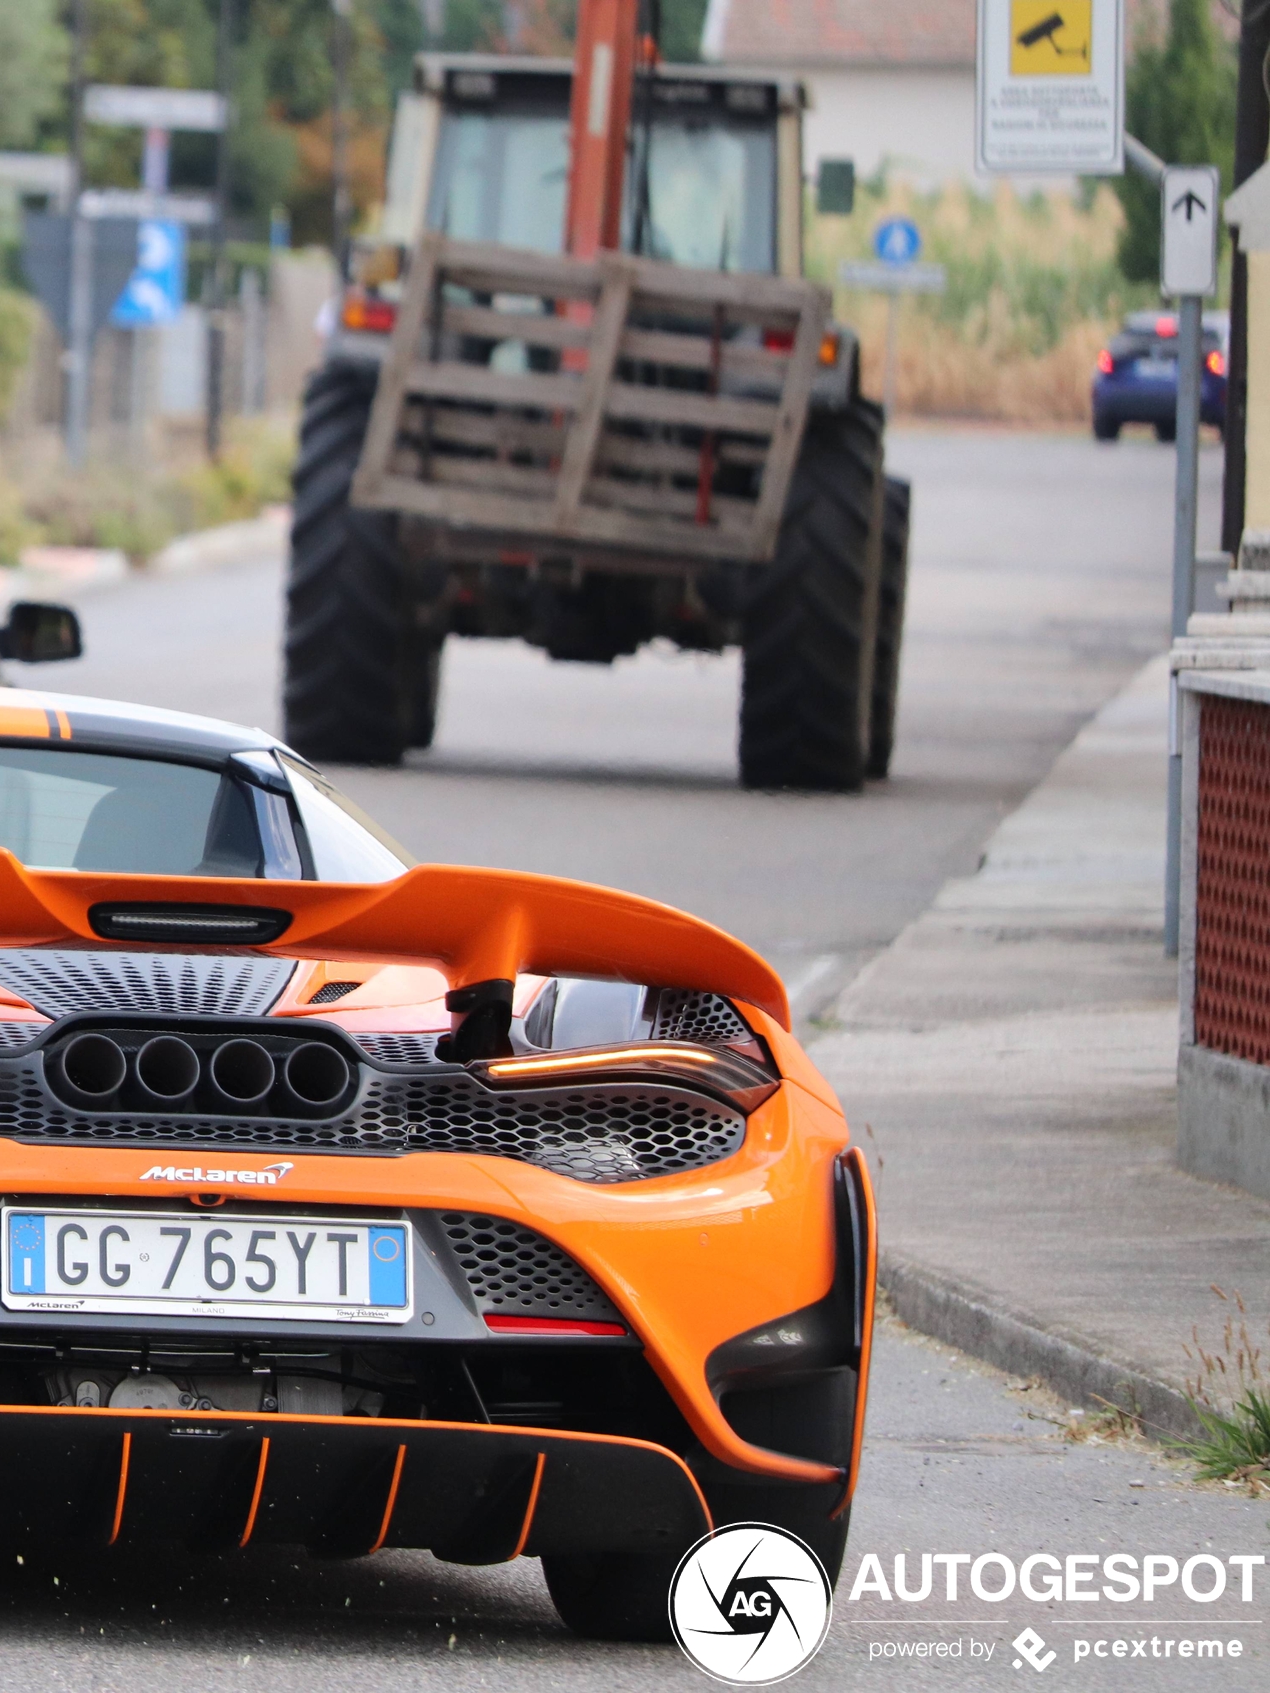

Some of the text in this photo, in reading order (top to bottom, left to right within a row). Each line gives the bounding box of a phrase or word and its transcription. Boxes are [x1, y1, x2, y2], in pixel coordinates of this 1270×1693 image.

[139, 1165, 277, 1185] McLaren
[56, 1222, 131, 1288] GG
[159, 1226, 359, 1296] 765YT
[26, 1300, 80, 1310] McLaren
[191, 1307, 225, 1315] MILANO
[335, 1308, 355, 1320] Tony
